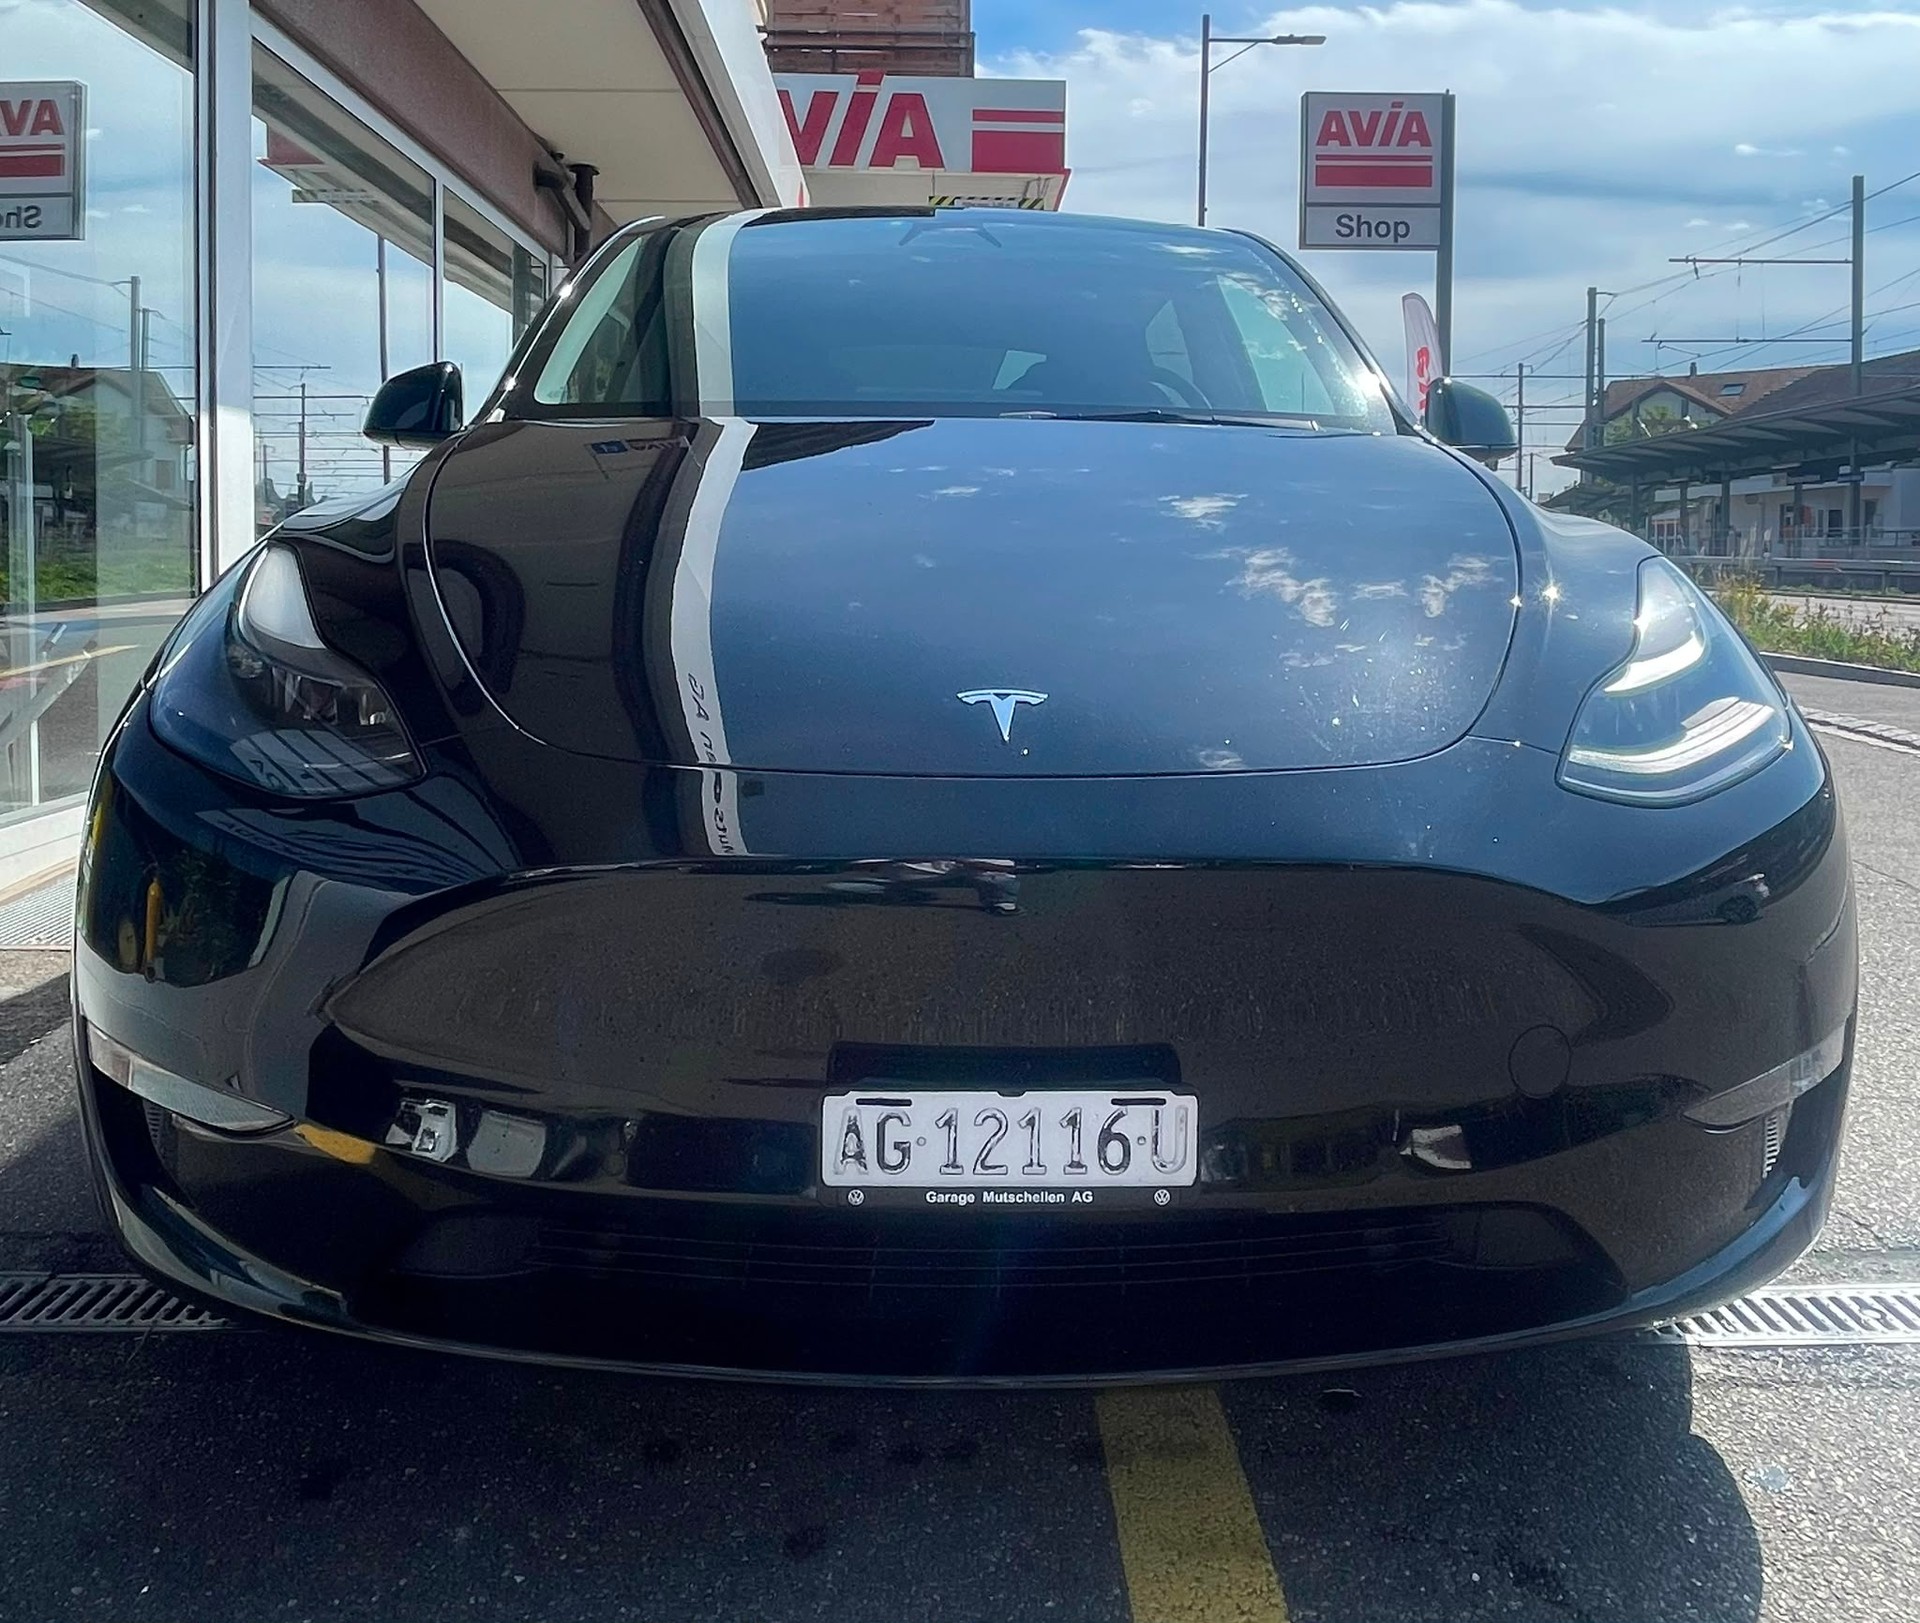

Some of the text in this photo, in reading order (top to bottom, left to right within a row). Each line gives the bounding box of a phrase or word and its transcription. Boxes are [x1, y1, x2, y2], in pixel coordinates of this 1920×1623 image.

[1316, 101, 1432, 147] AVIA
[1335, 213, 1411, 243] Shop
[925, 1191, 1094, 1206] Garage Mutschellen AG
